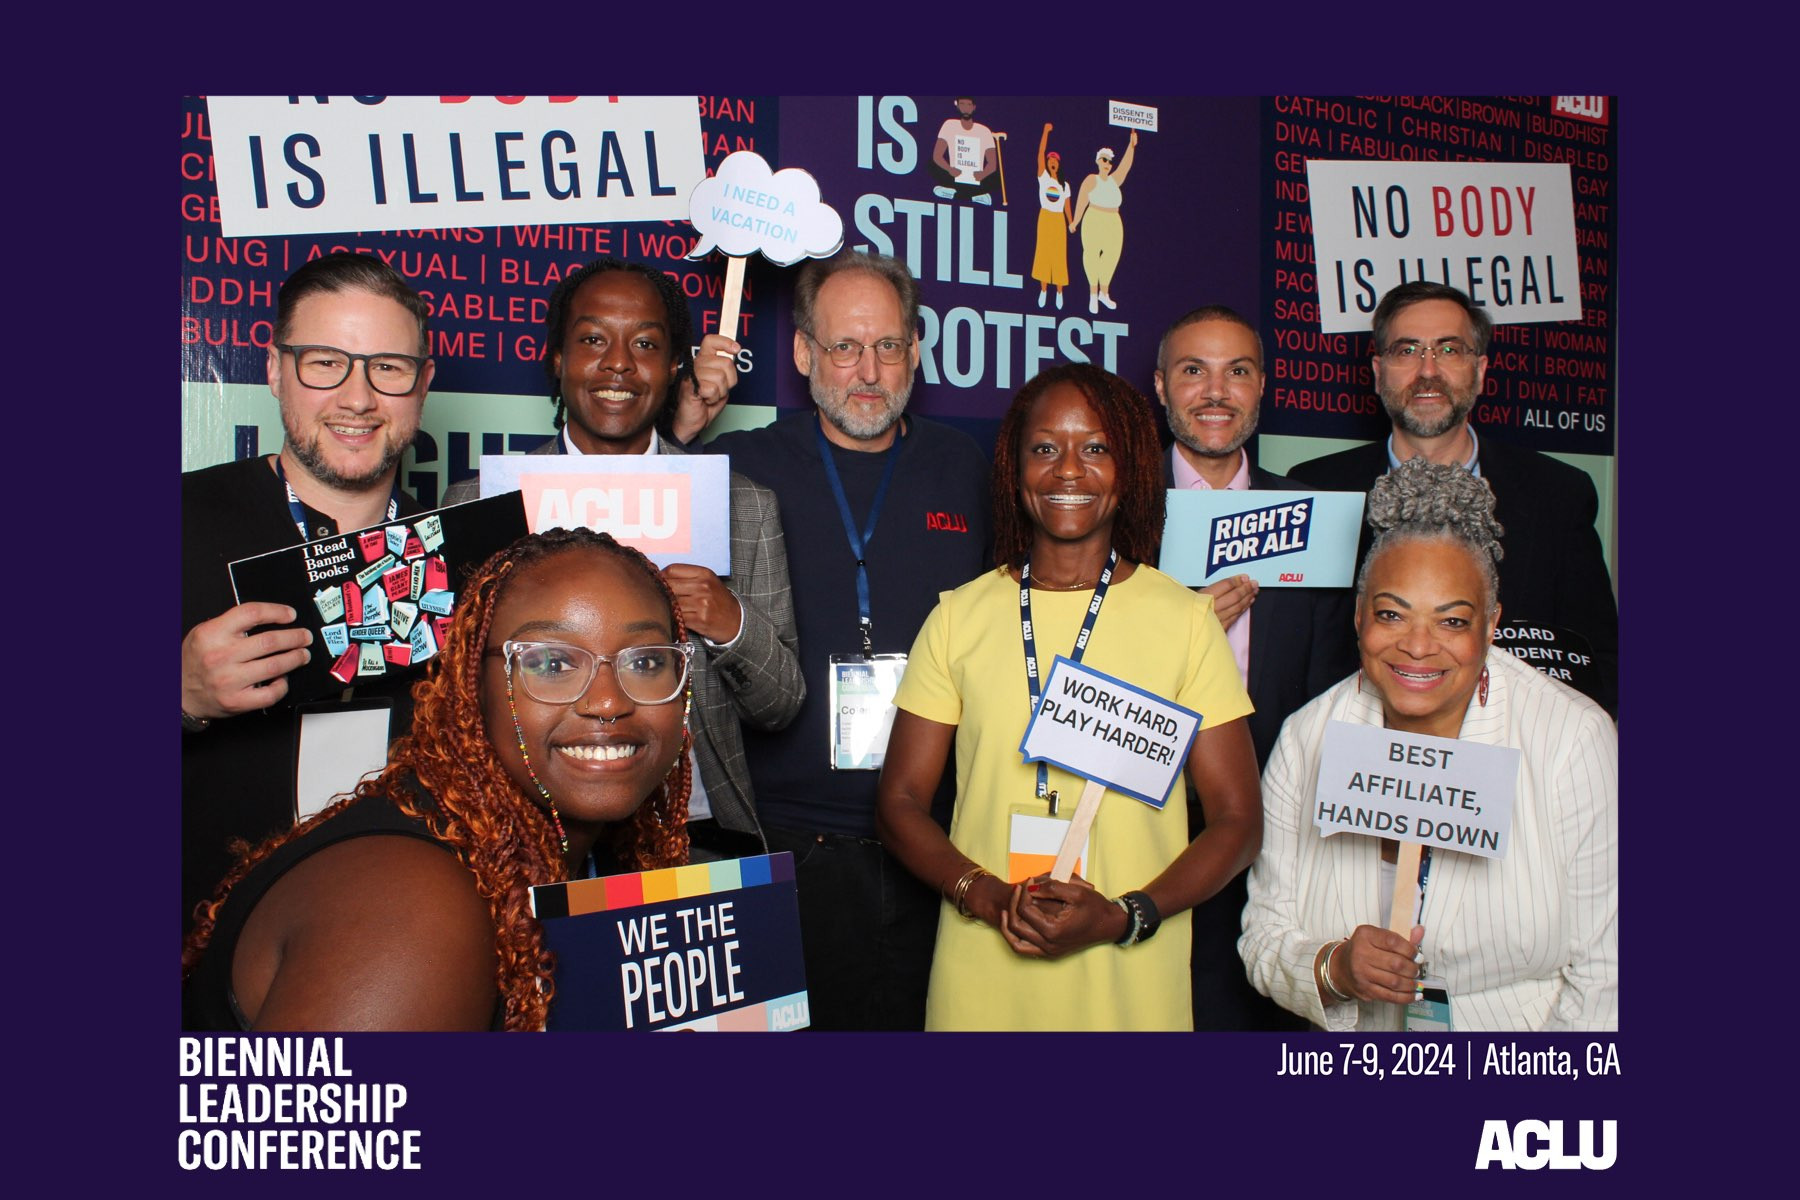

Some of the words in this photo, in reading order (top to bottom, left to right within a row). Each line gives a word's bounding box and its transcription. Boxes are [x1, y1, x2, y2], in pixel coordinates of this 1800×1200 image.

[1113, 106, 1144, 118] DISSENT
[1146, 111, 1154, 120] IS
[1113, 114, 1154, 126] PATRIOTIC
[858, 96, 918, 175] IS
[1275, 96, 1377, 129] CATHOLIC
[1401, 116, 1501, 152] CHRISTIAN
[1524, 139, 1608, 171] DISABLED
[1276, 121, 1321, 148] DIVA
[1340, 133, 1438, 161] FABULOUS
[1532, 114, 1608, 145] BUDDHIST
[249, 133, 326, 209] IS
[368, 129, 676, 205] ILLEGAL
[723, 183, 730, 198] I
[732, 185, 780, 211] NEED
[783, 200, 795, 217] A
[1577, 176, 1608, 197] GAY
[711, 206, 799, 243] VACATION
[1352, 185, 1410, 238] NO
[1432, 186, 1536, 237] BODY
[514, 224, 610, 254] WHITE
[853, 193, 1024, 289] STILL
[1335, 258, 1378, 315] IS
[703, 310, 754, 337] FT
[916, 305, 1129, 389] ROTEST
[1274, 328, 1347, 355] YOUNG
[1492, 326, 1530, 346] HITE
[1544, 330, 1607, 354] WOMAN
[1275, 358, 1370, 385] BUDDHIS
[1545, 356, 1607, 380] BROWN
[1519, 380, 1559, 402] DIVA
[1577, 386, 1607, 406] FAT
[1275, 388, 1377, 414] FABULOUS
[1478, 404, 1512, 425] GAY
[1524, 408, 1554, 428] ALL
[1558, 411, 1580, 430] OF
[1584, 413, 1606, 432] US
[535, 487, 679, 540] ACLU
[926, 511, 967, 533] ACLU
[1214, 503, 1308, 541] RIGHTS
[302, 548, 310, 560] I
[313, 538, 348, 557] Read
[306, 548, 356, 571] Banned
[1212, 537, 1259, 566] FOR
[1261, 528, 1304, 555] ALL
[309, 564, 350, 583] Books
[1279, 573, 1304, 583] ACLU
[1089, 594, 1103, 615] ACLU
[1022, 620, 1032, 641] ACLU
[1076, 627, 1091, 650] ACLU
[1494, 627, 1555, 642] BOARD
[1026, 656, 1038, 678] ACLU
[1535, 666, 1573, 681] EAR
[1567, 652, 1591, 666] OF
[1063, 676, 1124, 716] WORK
[1124, 703, 1179, 743] HARD,
[1039, 698, 1093, 732] PLAY
[1092, 719, 1176, 767] HARDER!
[1388, 742, 1453, 770] BEST
[1348, 772, 1481, 815] AFFILIATE,
[1317, 801, 1409, 834] HANDS
[1416, 817, 1500, 851] DOWN
[617, 913, 669, 956] WE
[676, 902, 736, 944] THE
[621, 940, 745, 1029] PEOPLE
[772, 1000, 808, 1031] ACLU
